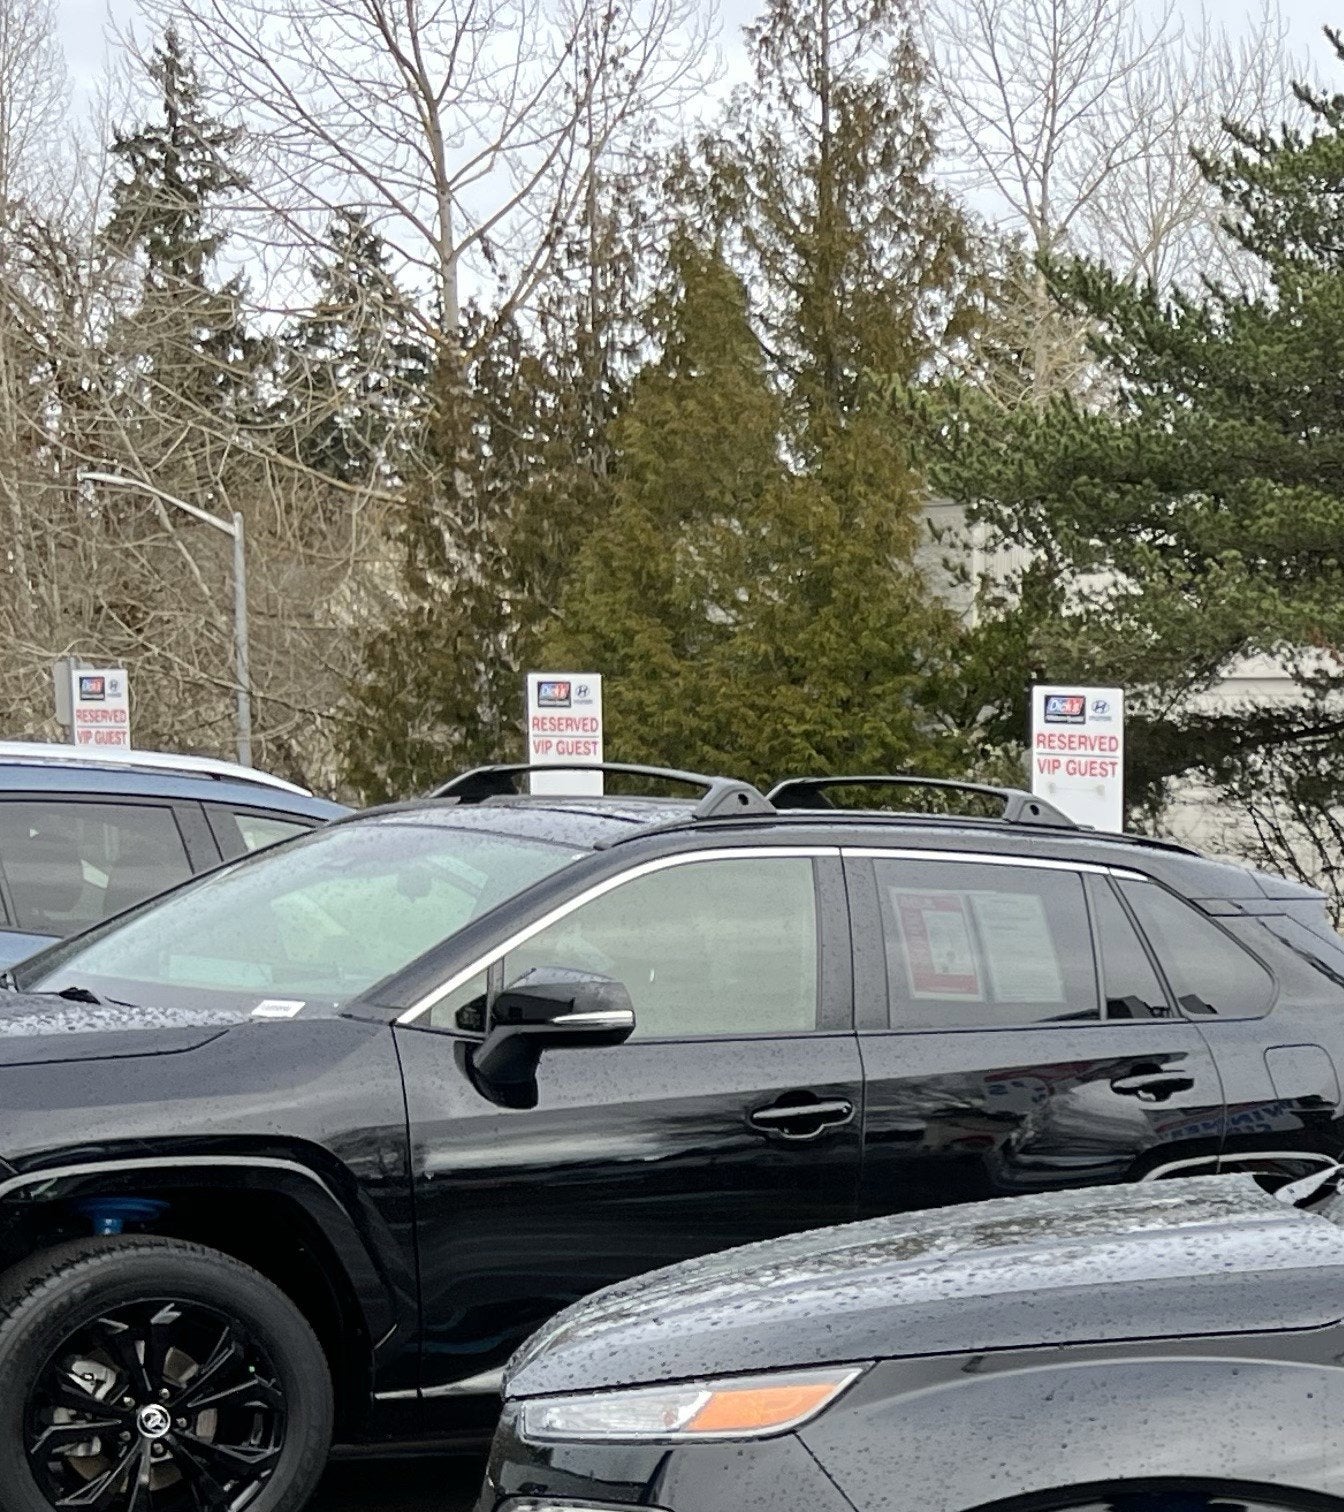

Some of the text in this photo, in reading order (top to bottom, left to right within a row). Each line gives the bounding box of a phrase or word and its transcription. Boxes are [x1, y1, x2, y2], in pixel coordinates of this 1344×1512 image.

[75, 708, 128, 723] RESERVED
[532, 716, 600, 733] RESERVED
[76, 730, 128, 745] VIP GUEST
[1036, 733, 1119, 752] RESERVED
[532, 740, 599, 756] VIP GUEST
[1037, 758, 1118, 778] VIP GUEST
